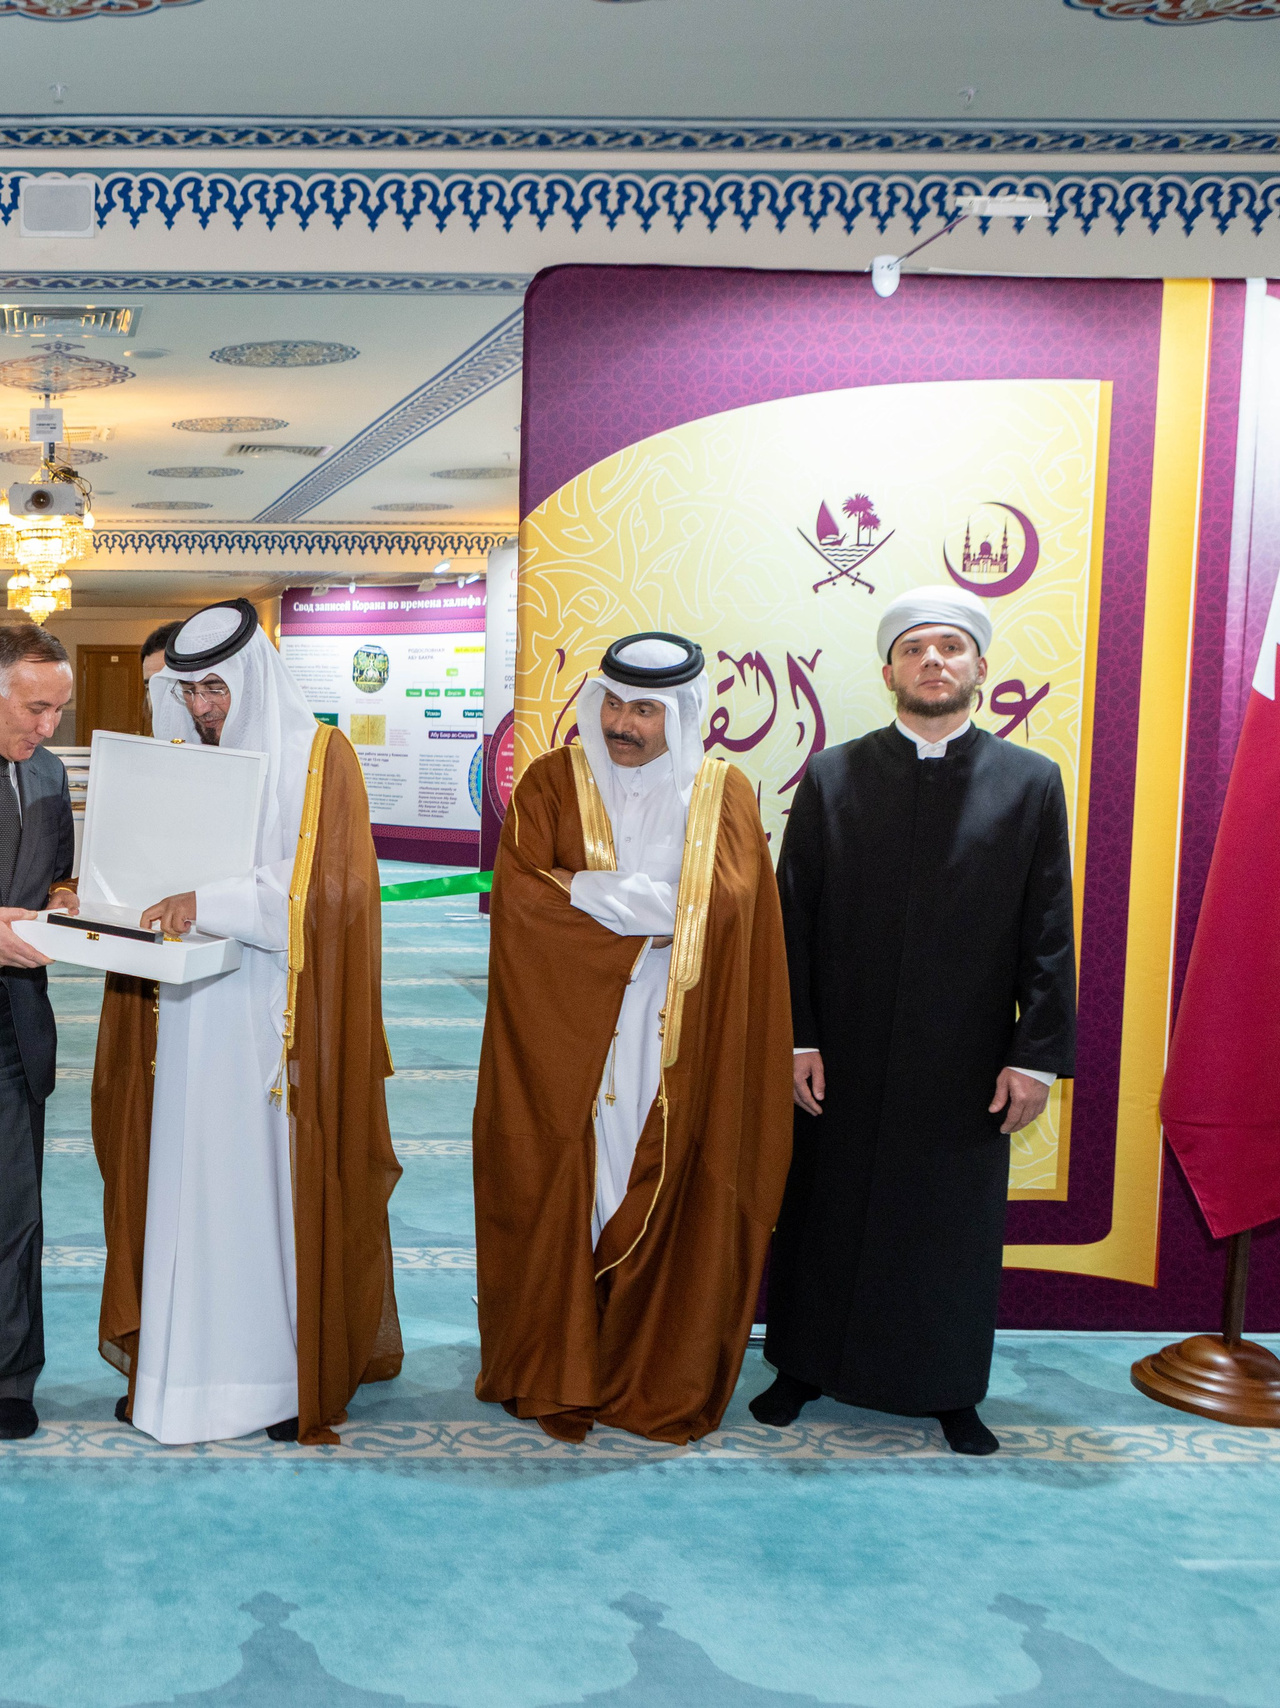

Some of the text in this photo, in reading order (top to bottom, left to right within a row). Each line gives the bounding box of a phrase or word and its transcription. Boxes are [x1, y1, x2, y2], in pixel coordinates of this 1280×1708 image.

[293, 602, 314, 613] Свод
[315, 600, 351, 612] записей
[352, 600, 386, 613] Корана
[387, 601, 399, 610] во
[400, 600, 441, 612] времена
[442, 595, 482, 609] халифа
